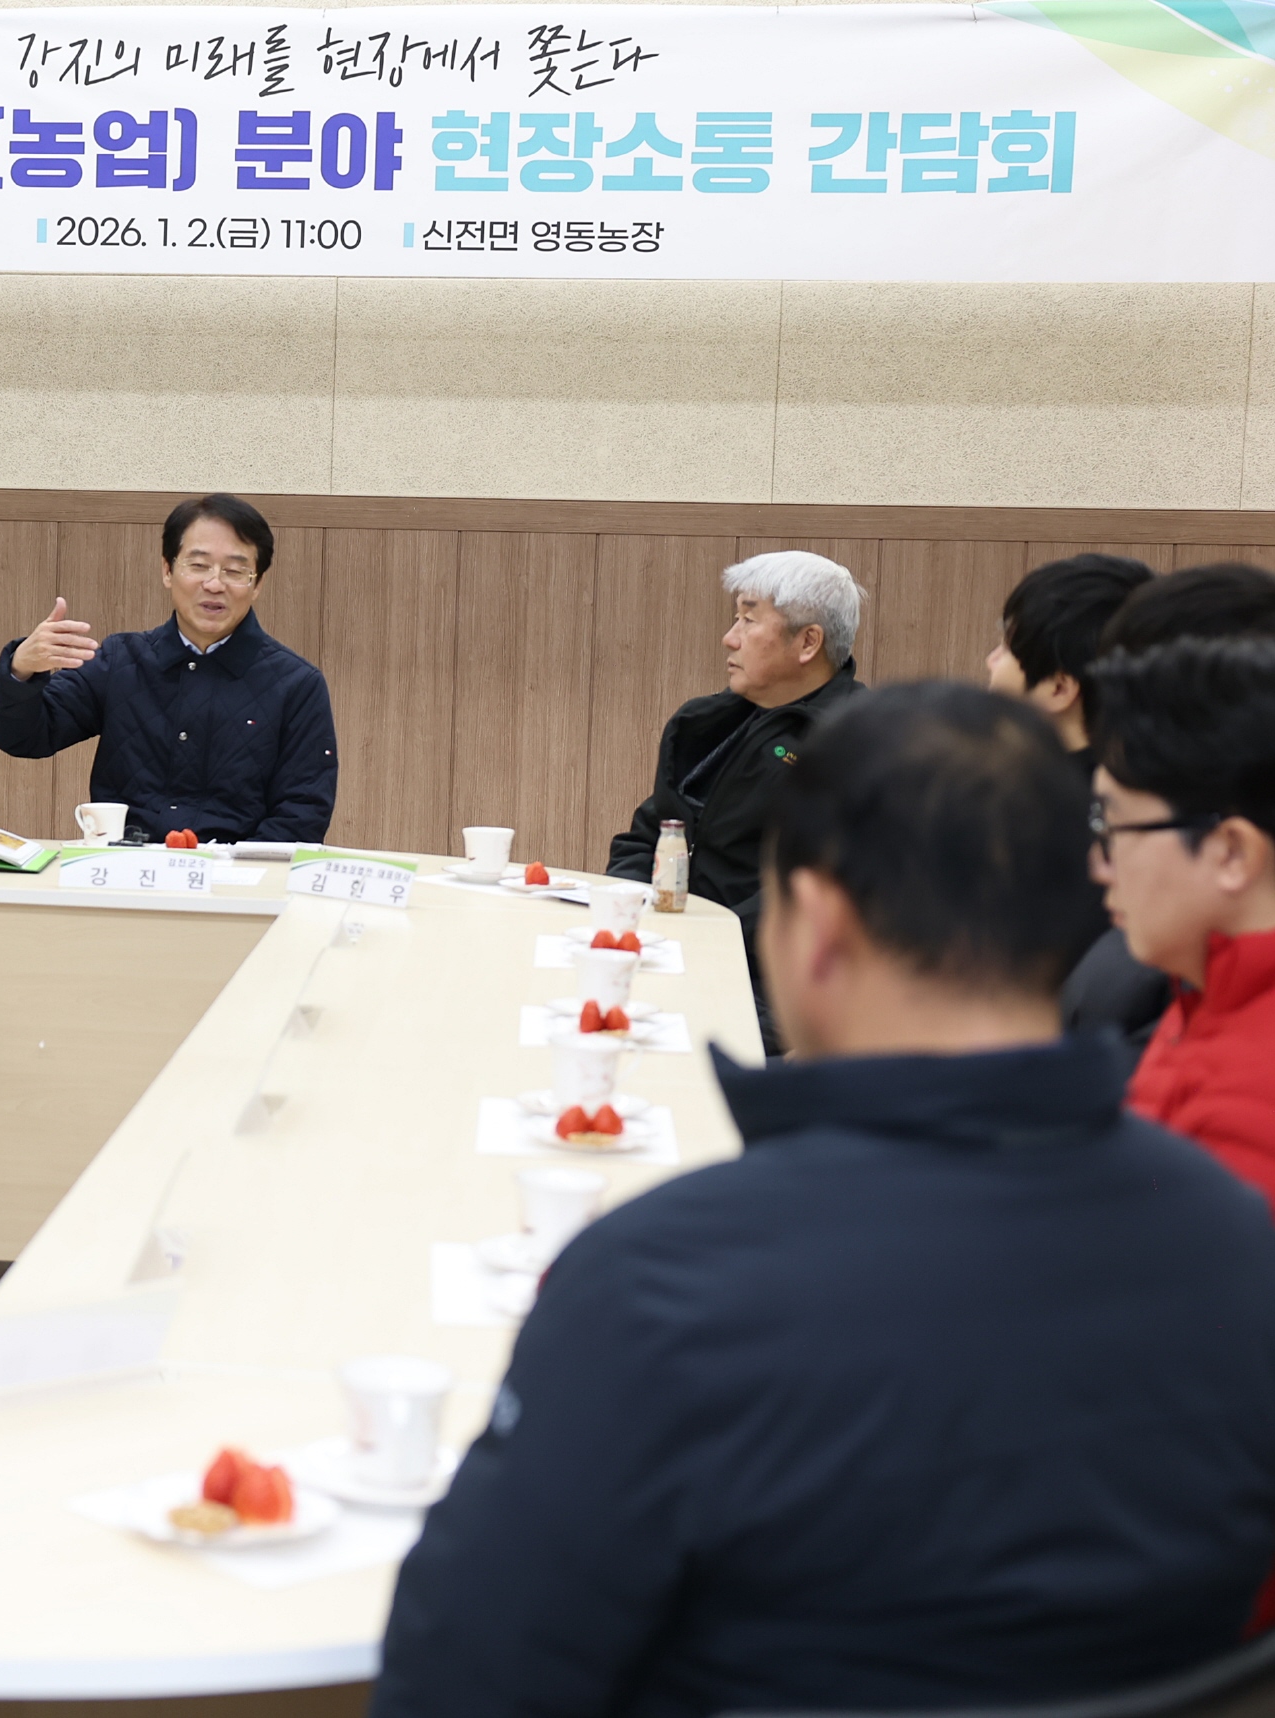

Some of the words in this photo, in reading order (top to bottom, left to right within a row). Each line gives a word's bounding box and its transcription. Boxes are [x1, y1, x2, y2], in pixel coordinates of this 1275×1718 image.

[18, 33, 141, 88] 강진의
[166, 24, 294, 97] 미래를
[317, 27, 500, 87] 현장에서
[528, 25, 659, 97] 쫓는다
[235, 110, 403, 190] 분야
[432, 111, 773, 193] 현장소통
[809, 110, 1076, 193] 간담회
[57, 216, 146, 246] 2026.
[158, 218, 176, 247] 1.
[281, 220, 361, 249] 11:00
[423, 220, 518, 251] 신전면
[532, 221, 664, 252] 영동농장
